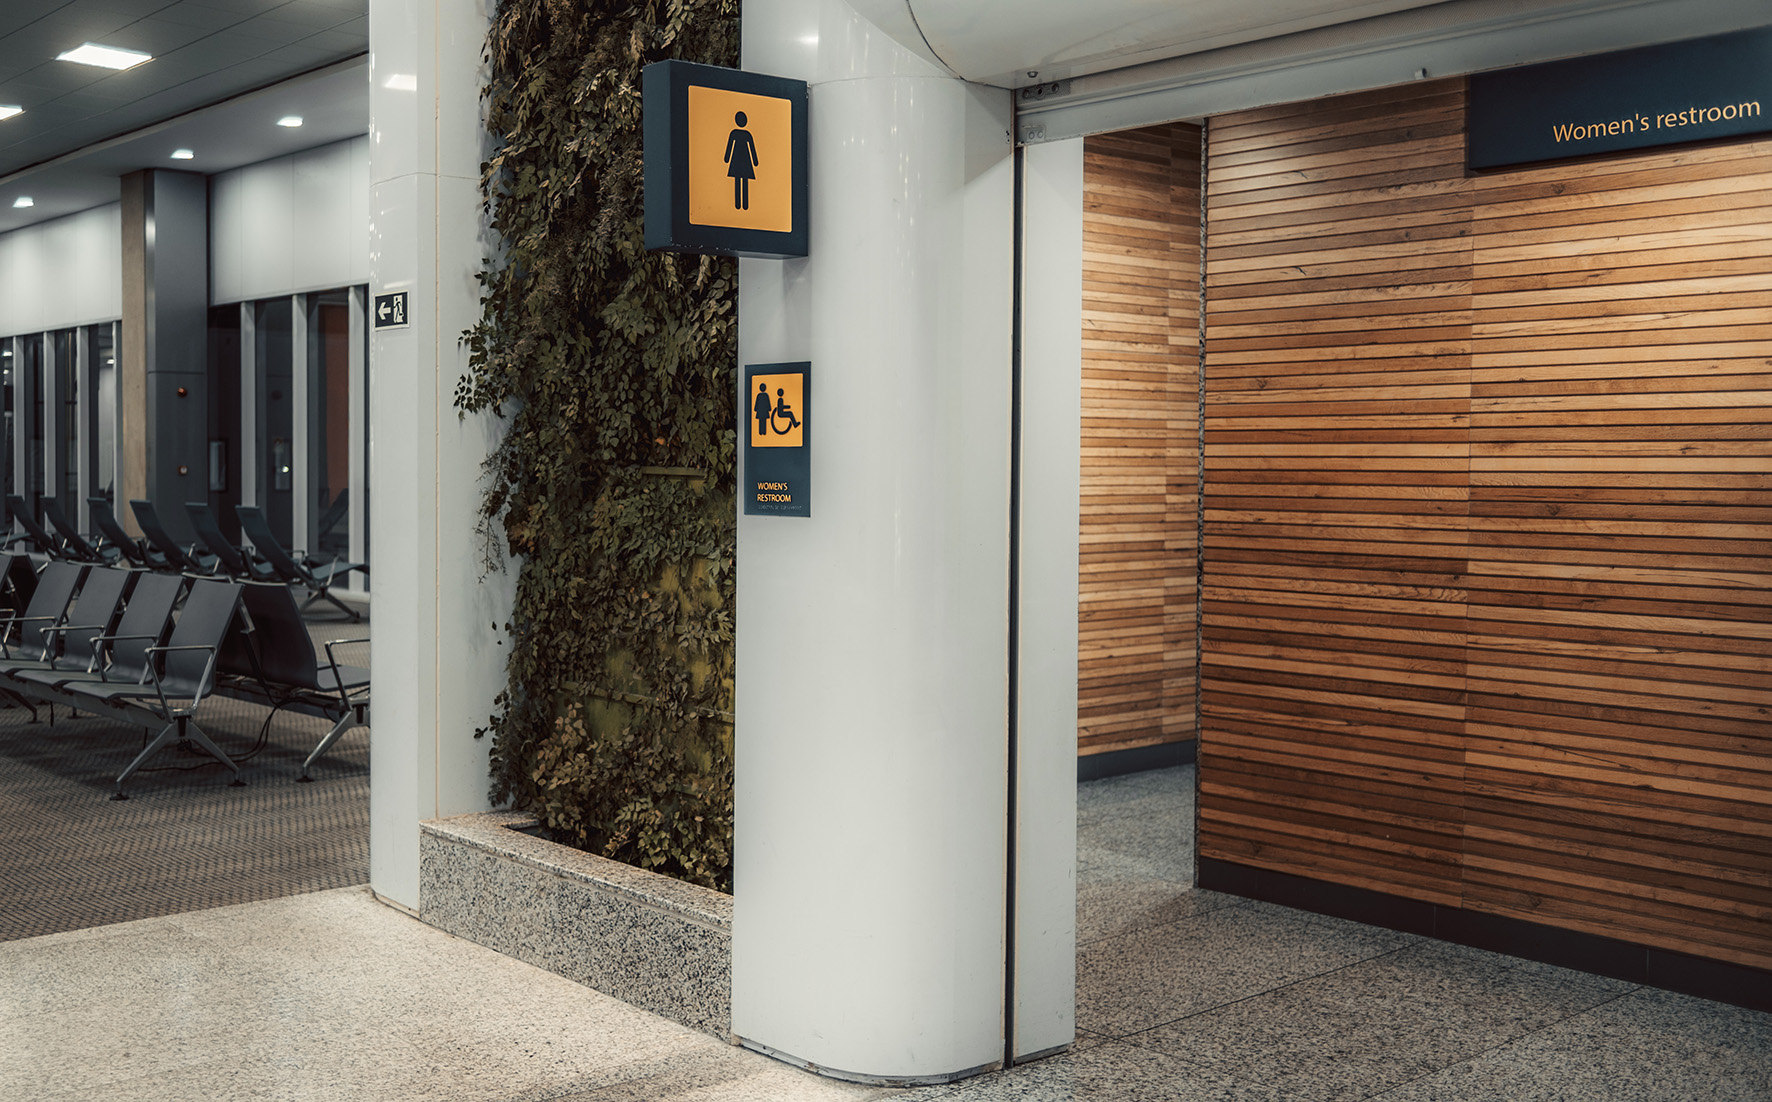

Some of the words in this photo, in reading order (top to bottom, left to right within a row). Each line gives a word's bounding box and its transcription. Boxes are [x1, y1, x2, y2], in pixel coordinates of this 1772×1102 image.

[1552, 113, 1650, 143] Women's
[1656, 100, 1761, 129] restroom
[757, 482, 788, 491] WOMEN'S
[757, 493, 791, 502] RESTROOM
